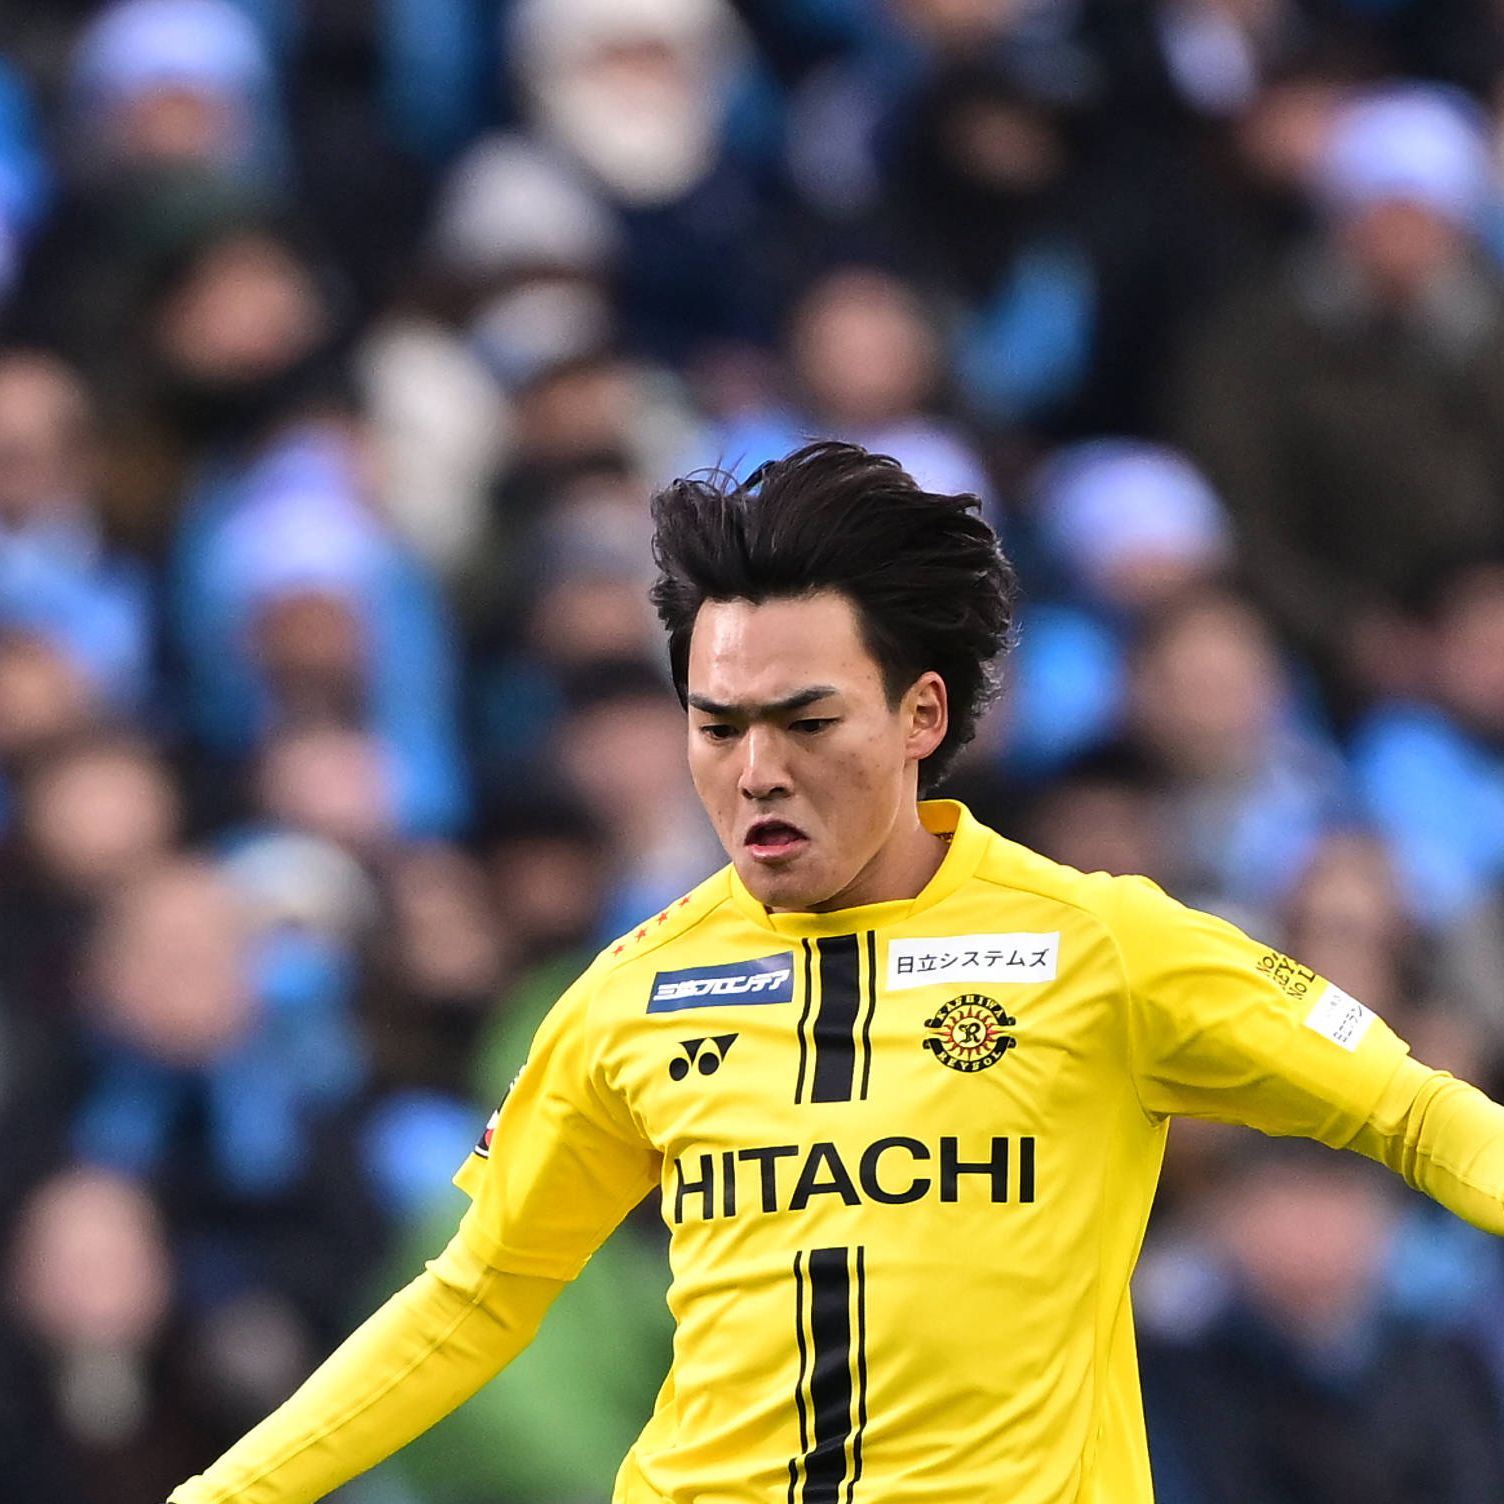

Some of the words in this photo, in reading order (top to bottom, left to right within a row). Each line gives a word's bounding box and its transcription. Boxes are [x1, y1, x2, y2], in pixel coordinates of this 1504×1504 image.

[897, 948, 1050, 975] 日立システムズ
[936, 994, 1004, 1020] KASHIWA
[936, 1050, 1002, 1071] REYSOL
[674, 1136, 1035, 1225] HITACHI
